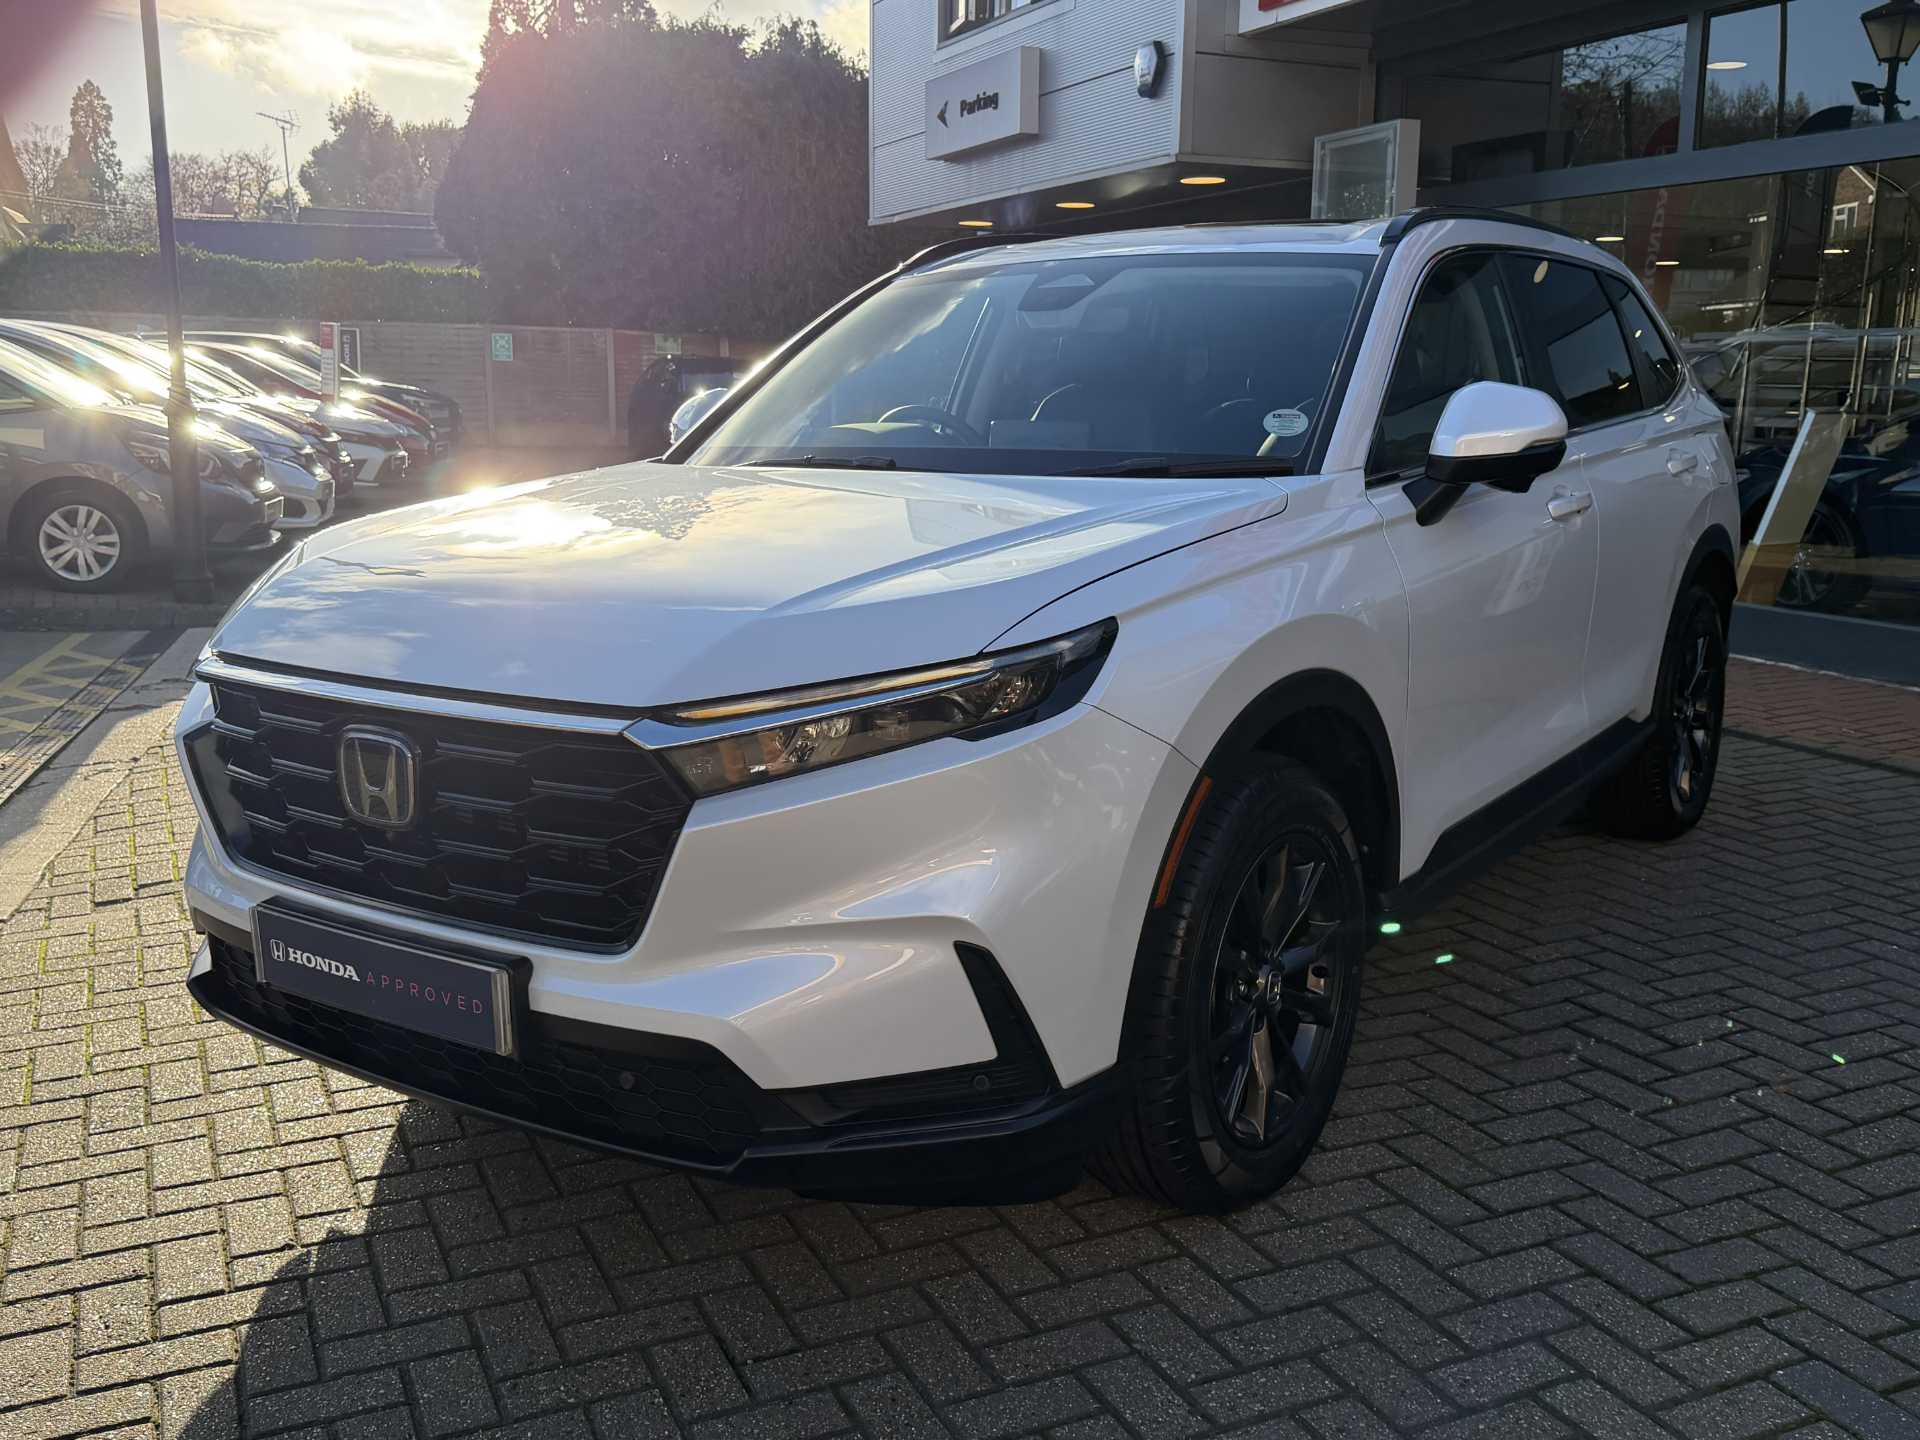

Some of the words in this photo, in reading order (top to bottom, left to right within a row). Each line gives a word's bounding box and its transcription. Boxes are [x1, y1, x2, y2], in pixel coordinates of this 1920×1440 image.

[960, 91, 999, 118] Parking
[287, 946, 361, 982] HONDA
[366, 971, 484, 1014] APPROVED
